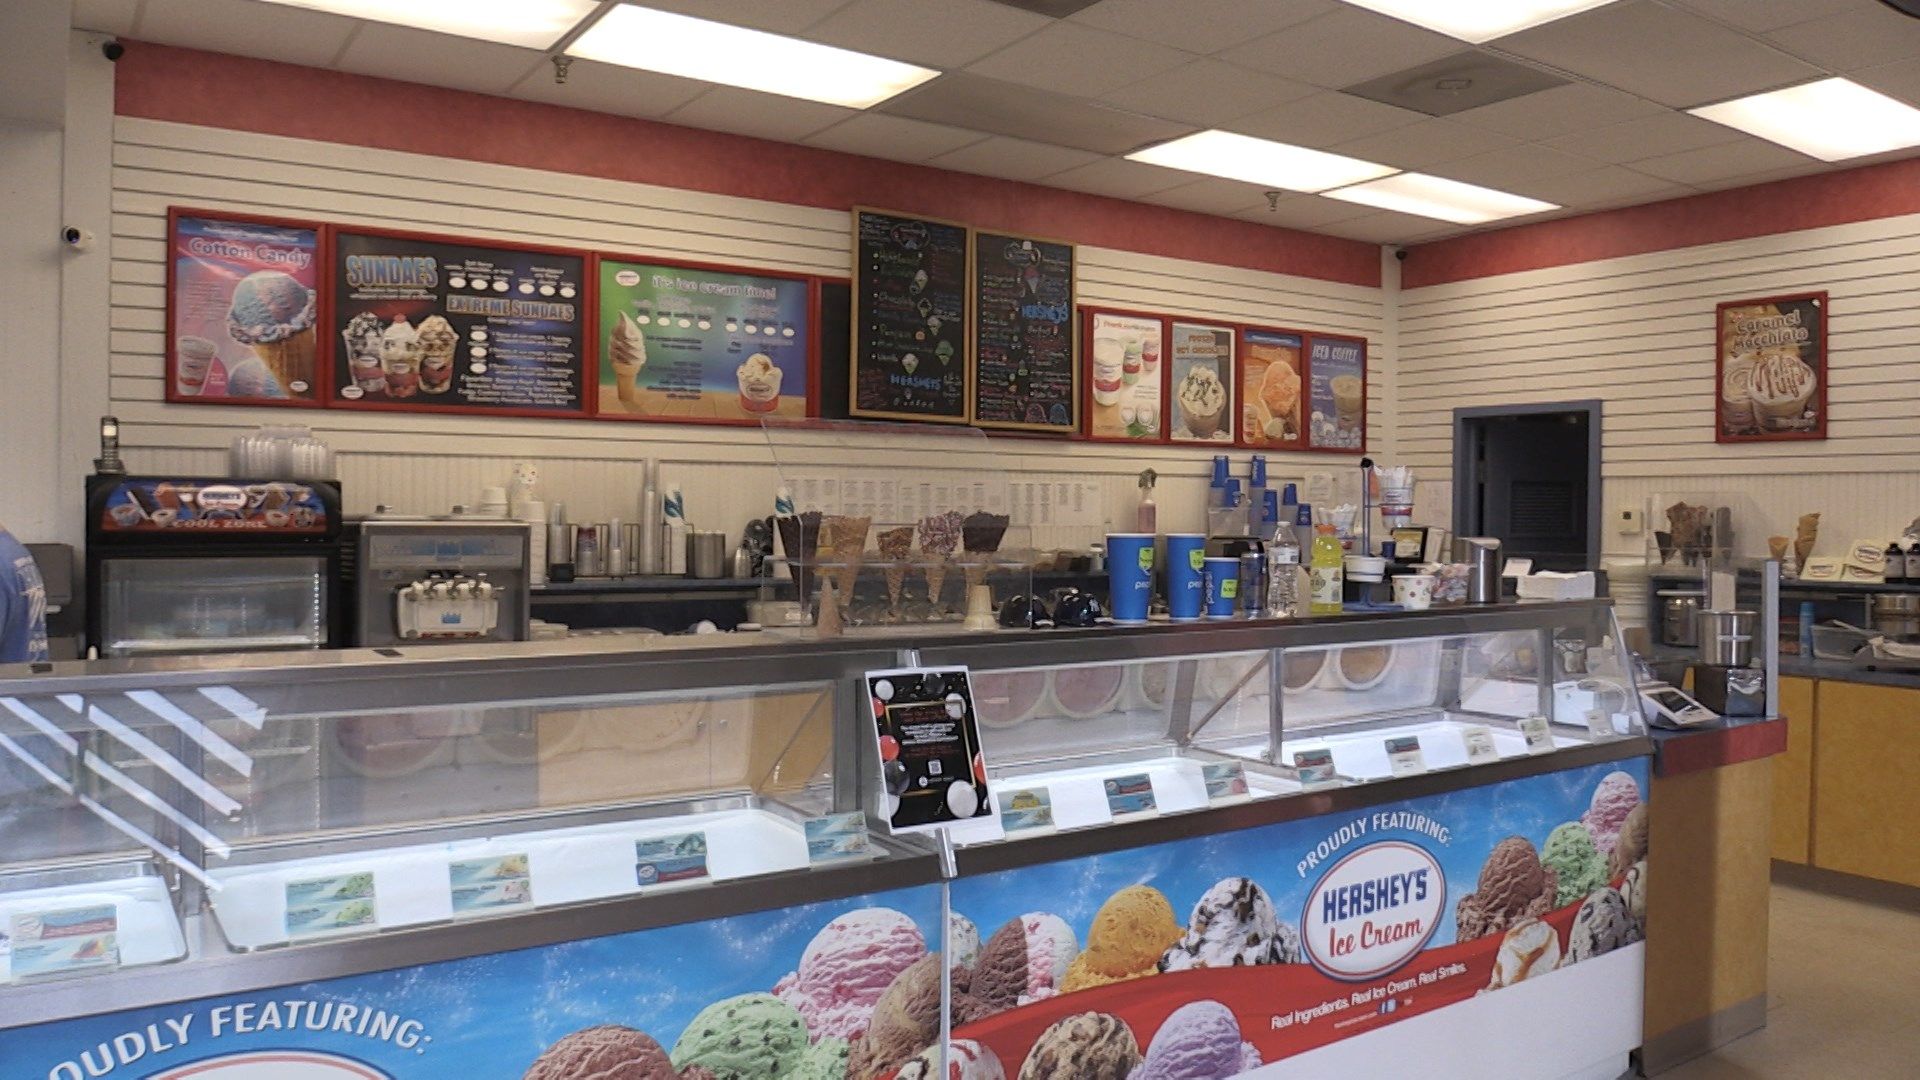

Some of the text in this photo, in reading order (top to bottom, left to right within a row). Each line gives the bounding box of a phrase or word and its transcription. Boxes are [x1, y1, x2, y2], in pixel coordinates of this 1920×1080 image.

[189, 237, 311, 270] Cotton Candy
[346, 254, 438, 288] SUNDAES
[446, 295, 511, 316] EXTREME
[511, 299, 575, 322] SUNDAES
[1736, 309, 1801, 335] Caramel
[1312, 344, 1359, 361] ICED COFFEE
[173, 519, 268, 528] COOL ZONE
[1296, 811, 1453, 878] PROUDLY FEATURING:
[1322, 868, 1429, 924] HERSHEY'S
[1329, 918, 1424, 957] Ice Cream
[1271, 1011, 1293, 1030] Real
[1351, 989, 1372, 1006] Real
[1373, 986, 1386, 999] Ice
[1418, 970, 1437, 985] Real
[211, 1000, 433, 1055] FEATURING:
